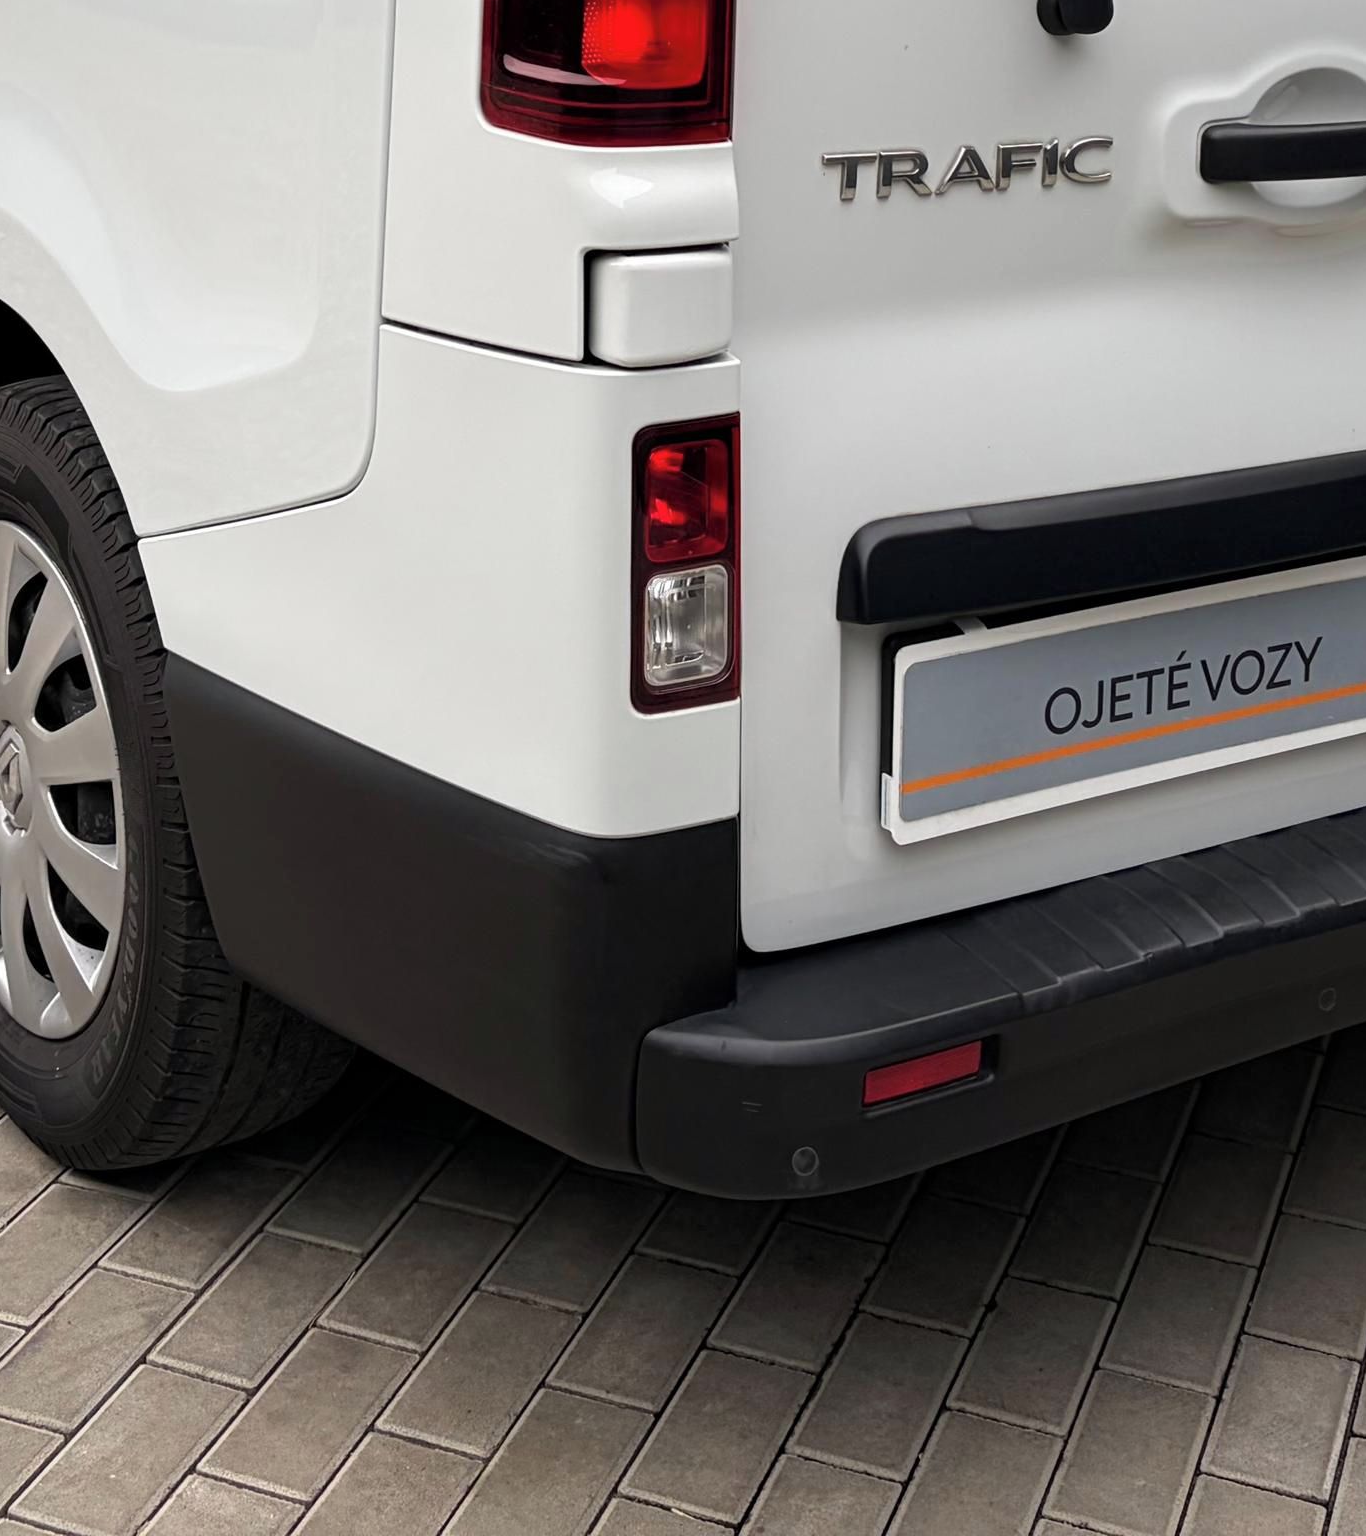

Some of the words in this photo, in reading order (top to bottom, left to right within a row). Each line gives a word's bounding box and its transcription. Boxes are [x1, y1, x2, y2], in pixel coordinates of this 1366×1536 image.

[821, 135, 1114, 202] TRAFIC
[1044, 649, 1192, 735] OJETÉ
[1201, 636, 1323, 701] VOZY
